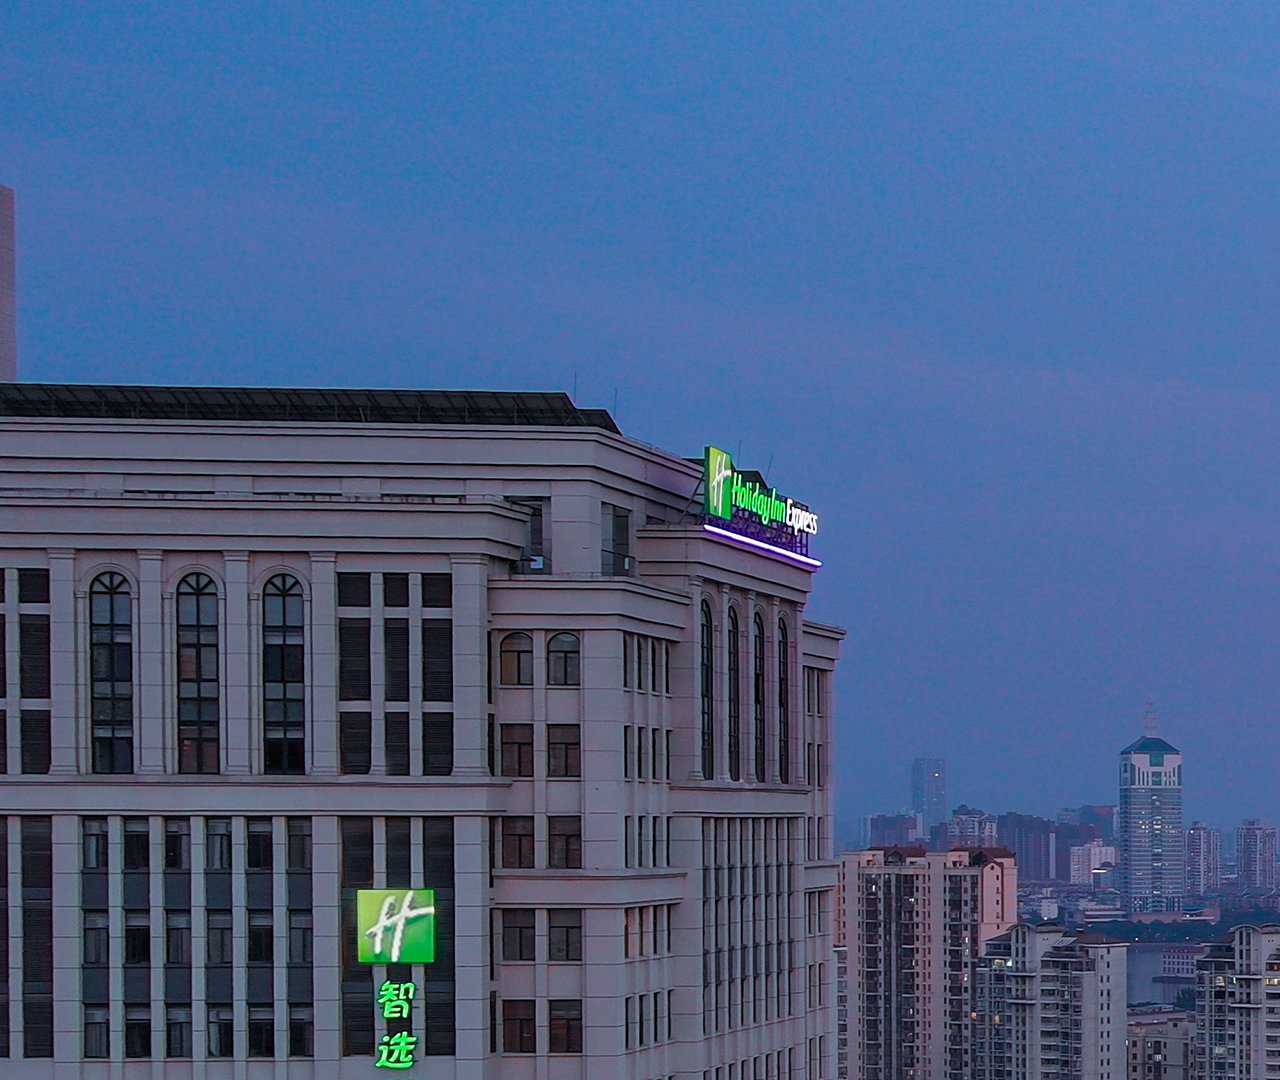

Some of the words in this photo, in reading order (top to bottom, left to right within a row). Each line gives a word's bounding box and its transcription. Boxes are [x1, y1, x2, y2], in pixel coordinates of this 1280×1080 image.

[732, 472, 770, 525] Holiday
[770, 488, 786, 523] Inn
[786, 498, 819, 536] Express
